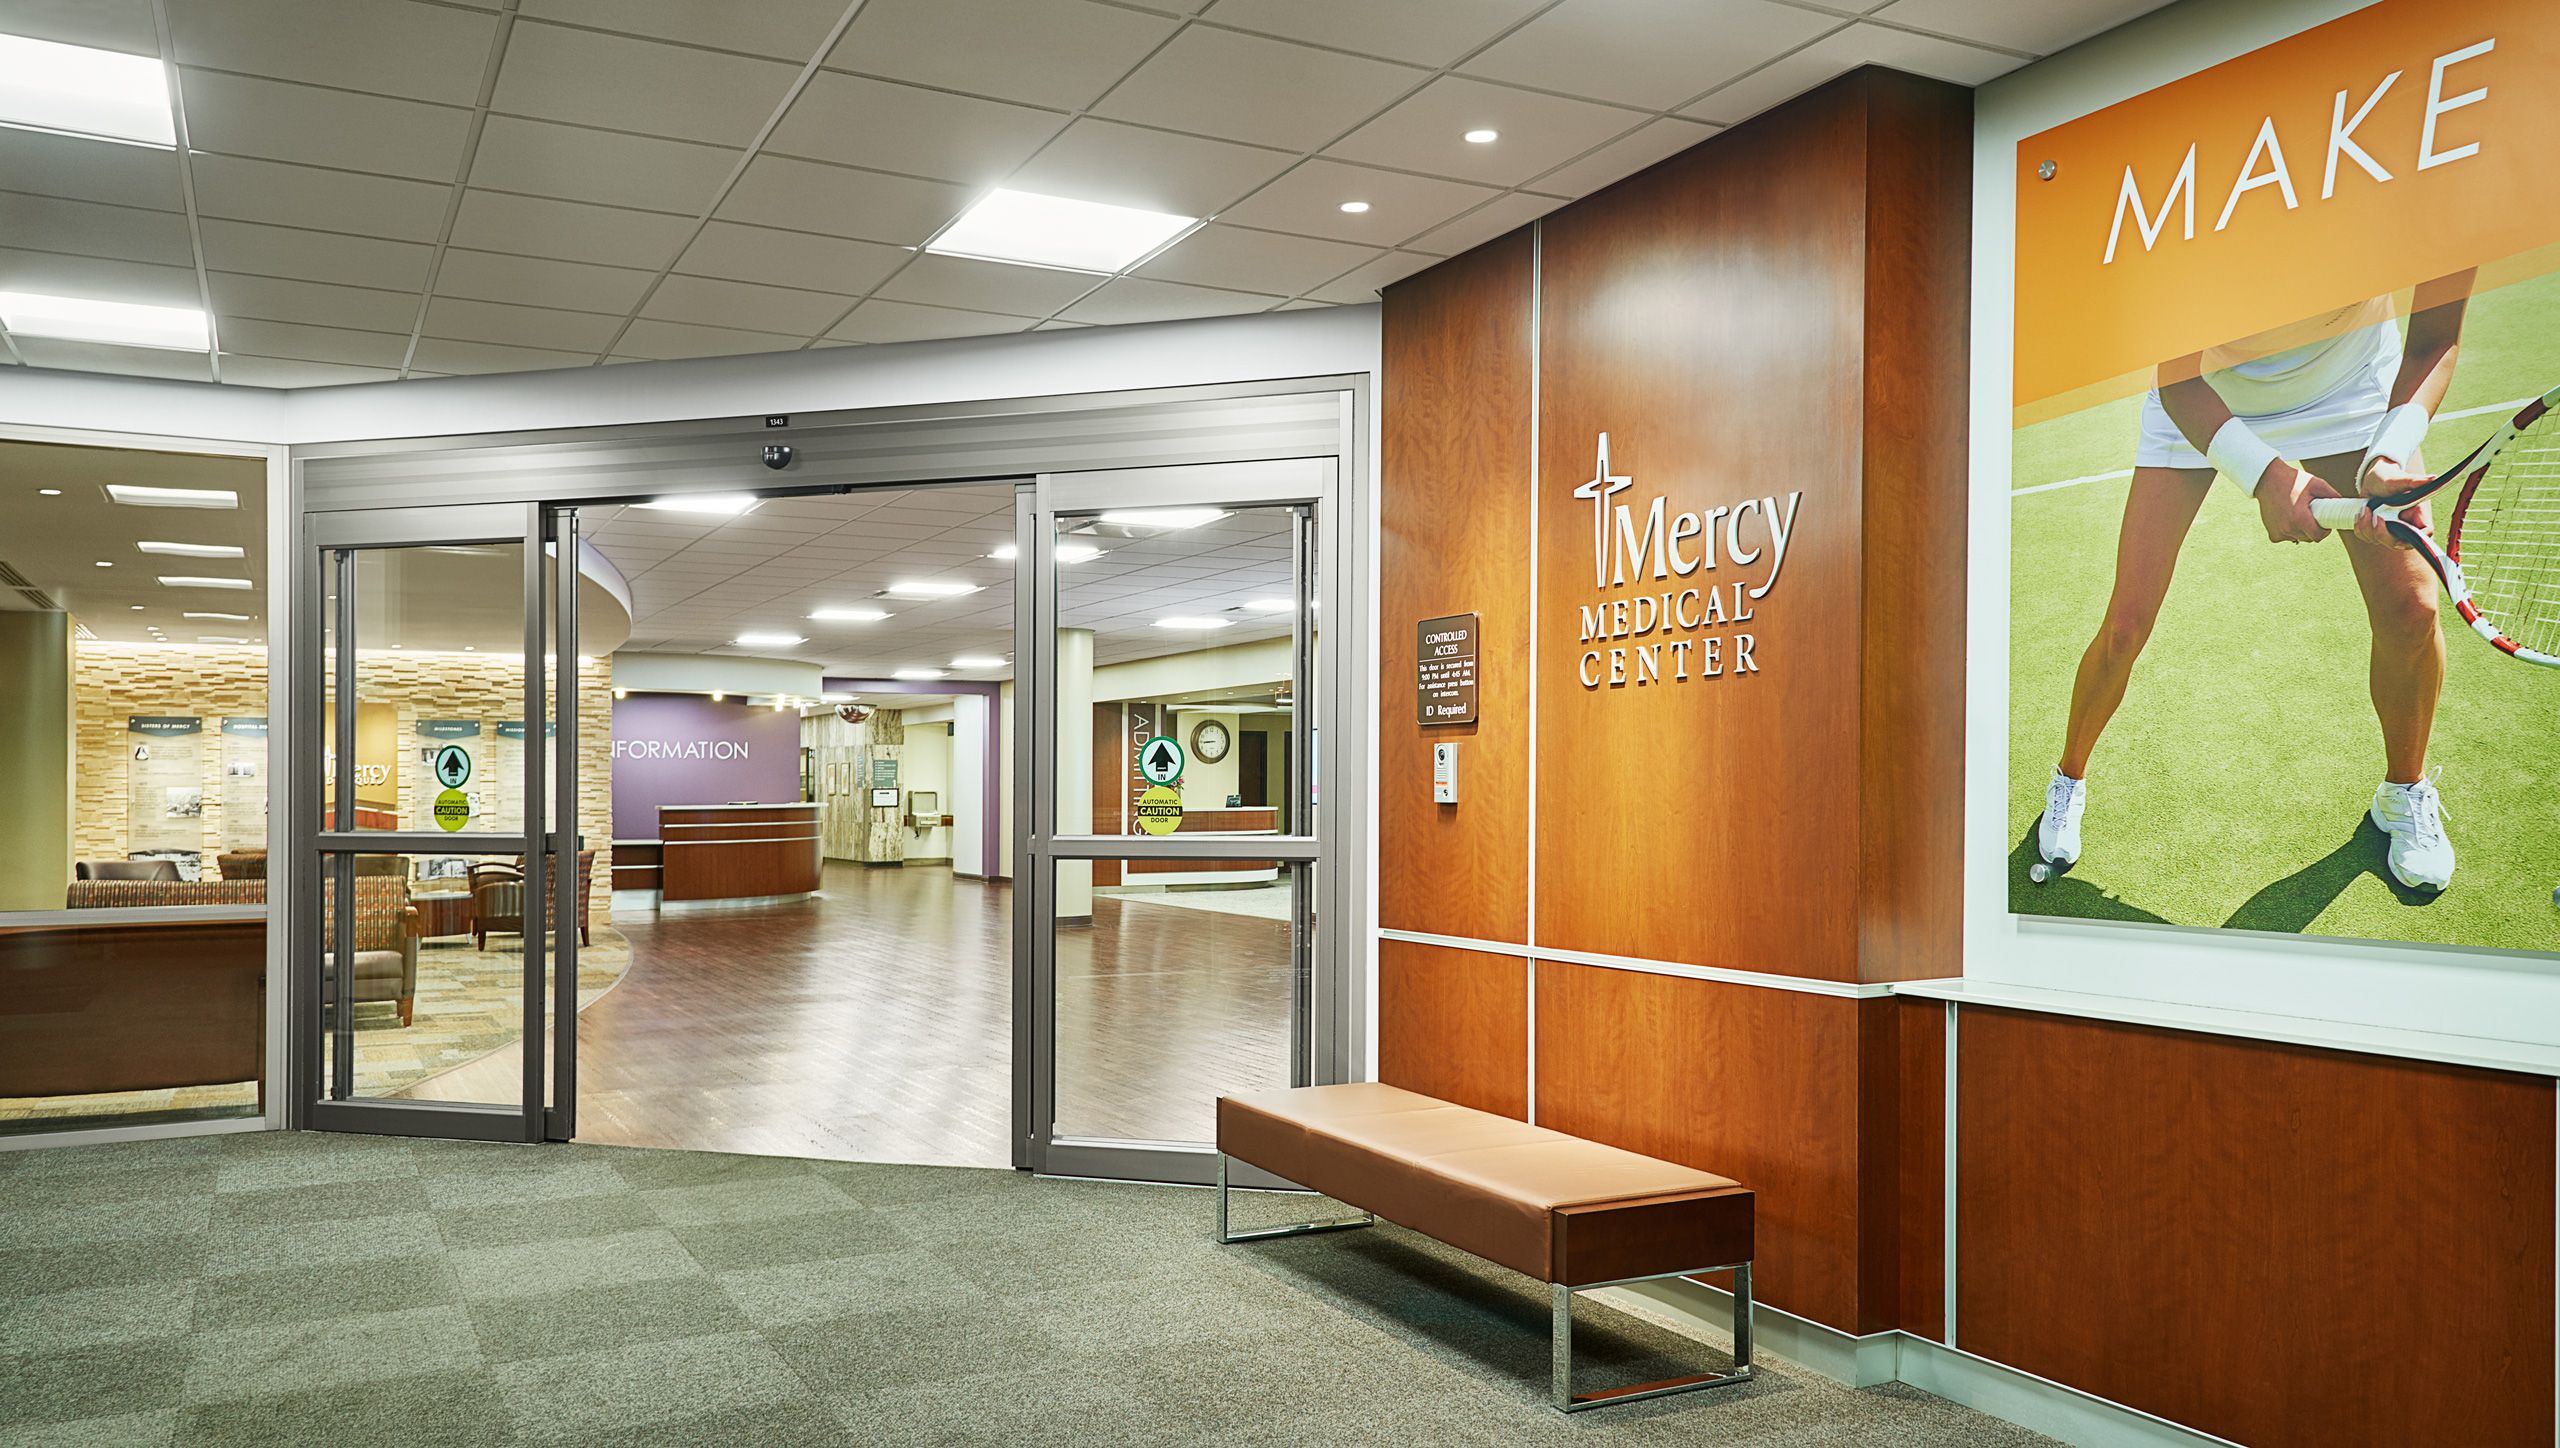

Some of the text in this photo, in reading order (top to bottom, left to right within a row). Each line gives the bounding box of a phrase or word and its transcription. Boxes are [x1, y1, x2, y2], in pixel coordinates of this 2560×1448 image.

[2102, 37, 2496, 265] MAKE
[1613, 491, 1803, 599] Mercy
[1578, 581, 1755, 644] MEDICAL
[1426, 630, 1467, 644] CONTROLLED
[1434, 643, 1458, 656] ACCESS
[1578, 633, 1760, 689] CENTER
[1425, 702, 1467, 718] ID Required
[1157, 773, 1166, 781] IN
[436, 806, 468, 815] CAUTION
[1140, 807, 1180, 816] CAUTION
